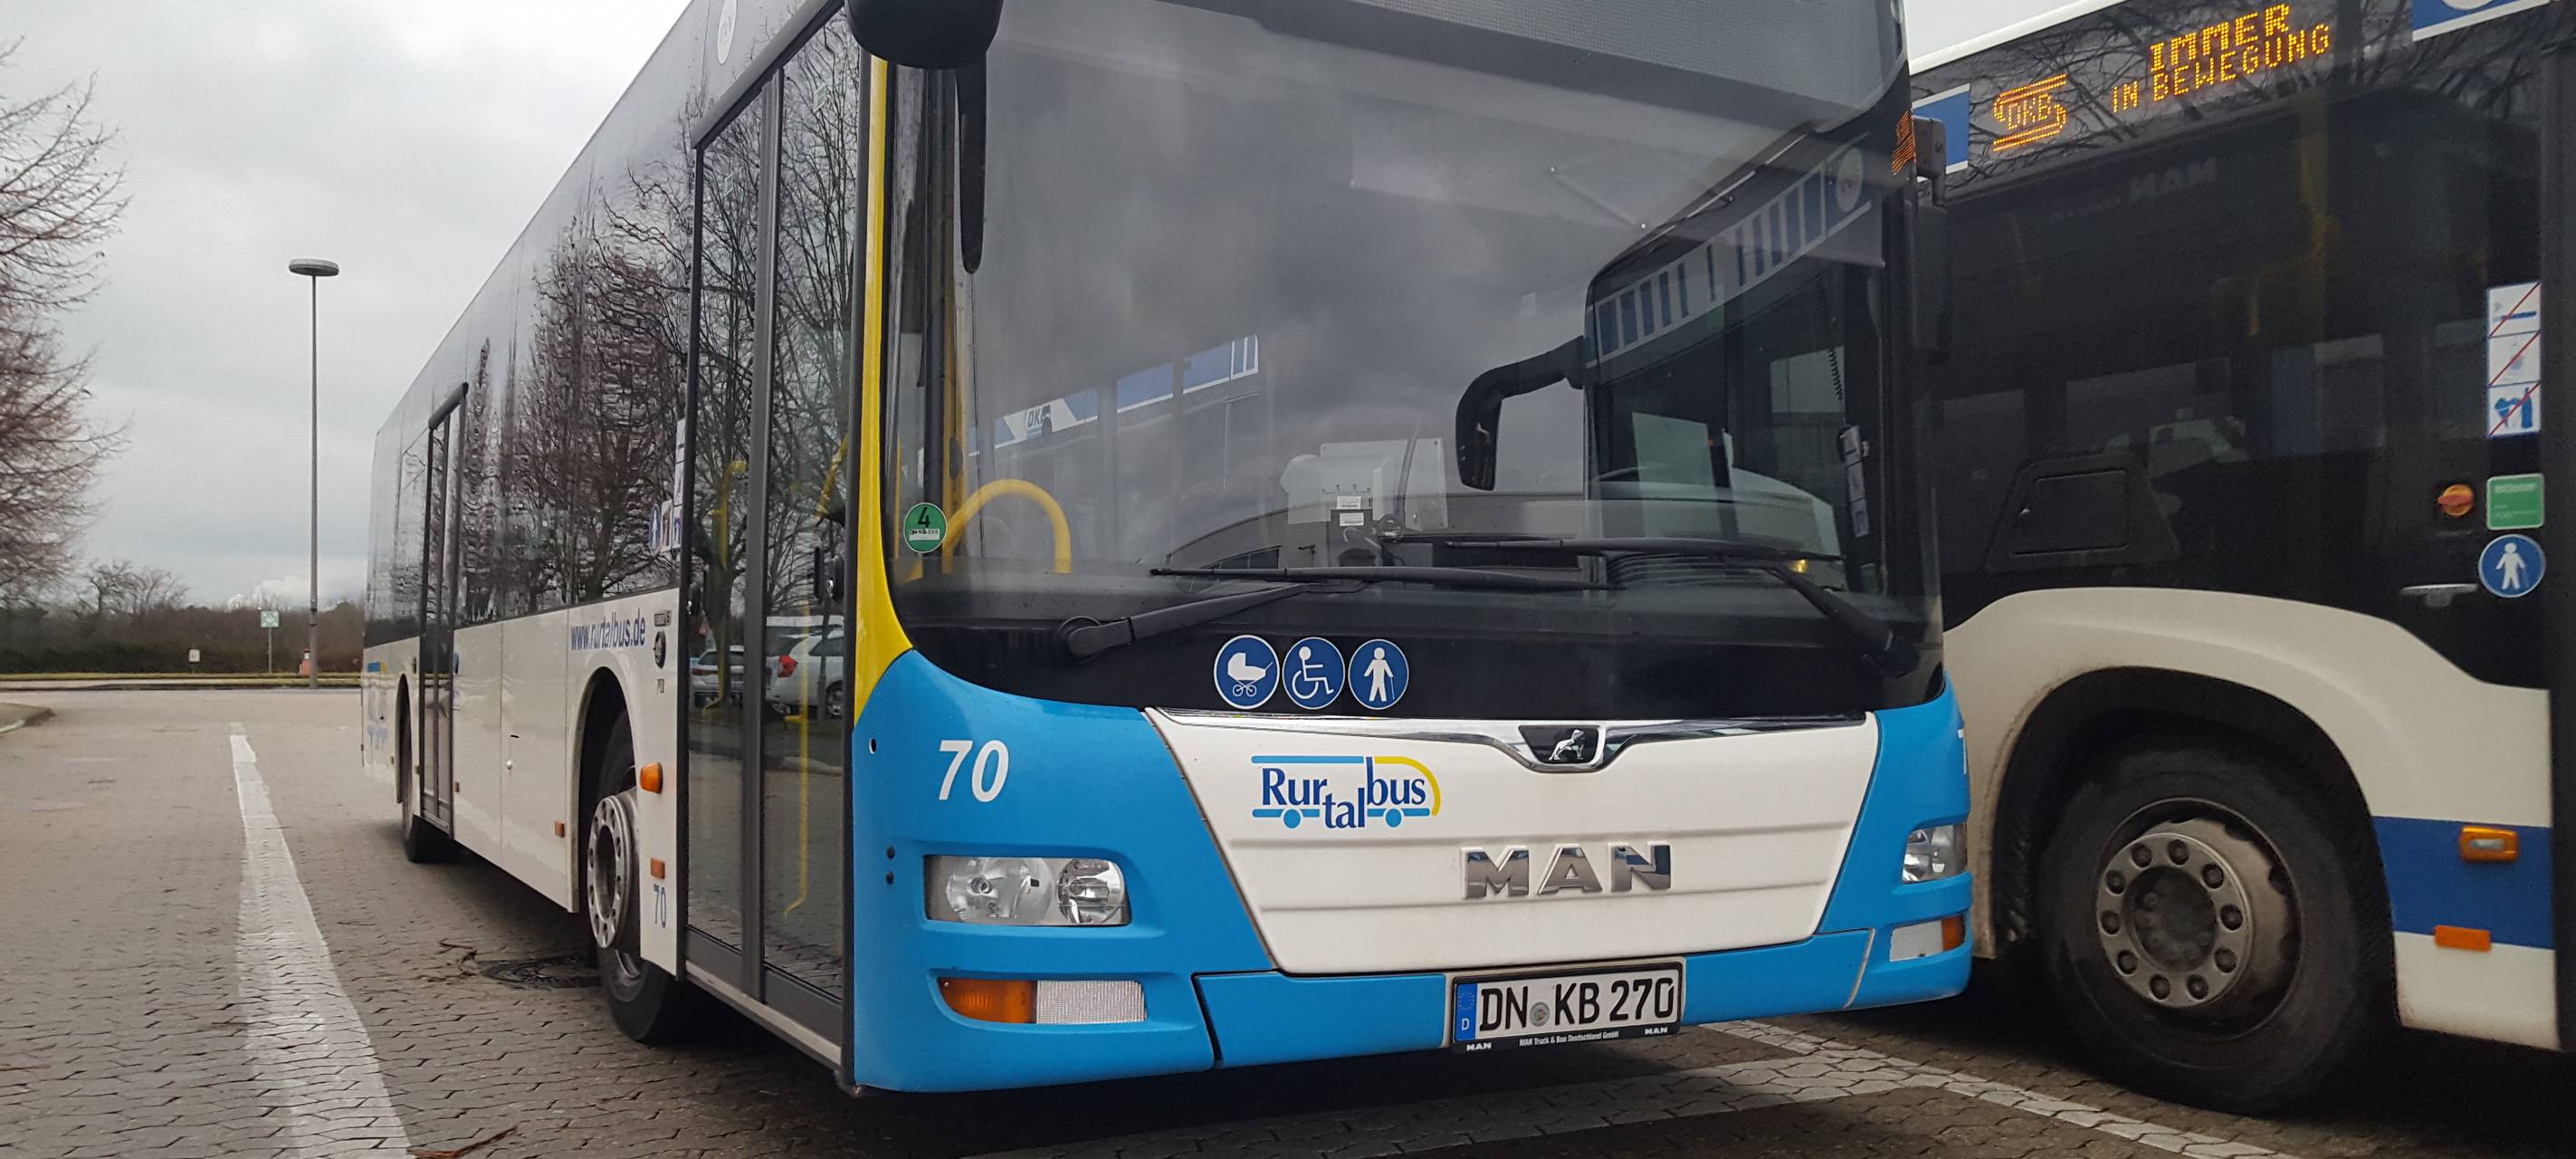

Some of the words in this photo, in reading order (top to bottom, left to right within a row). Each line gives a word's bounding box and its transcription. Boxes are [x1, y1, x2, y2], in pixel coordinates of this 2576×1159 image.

[2150, 3, 2290, 73] IMMER
[2113, 80, 2138, 113] IN
[2153, 24, 2330, 102] BEWEGUNG
[2007, 91, 2052, 131] DKB
[917, 506, 930, 528] 4
[571, 608, 646, 651] www.rurtalbus.de
[937, 738, 1011, 803] 70
[1463, 843, 1672, 899] MAN
[653, 884, 667, 930] 70
[1461, 1018, 1470, 1030] D
[1479, 985, 1529, 1032] DN
[1554, 982, 1600, 1026] KB
[1609, 977, 1674, 1022] 270
[1465, 1042, 1493, 1051] MAN
[1644, 1026, 1668, 1035] MAN
